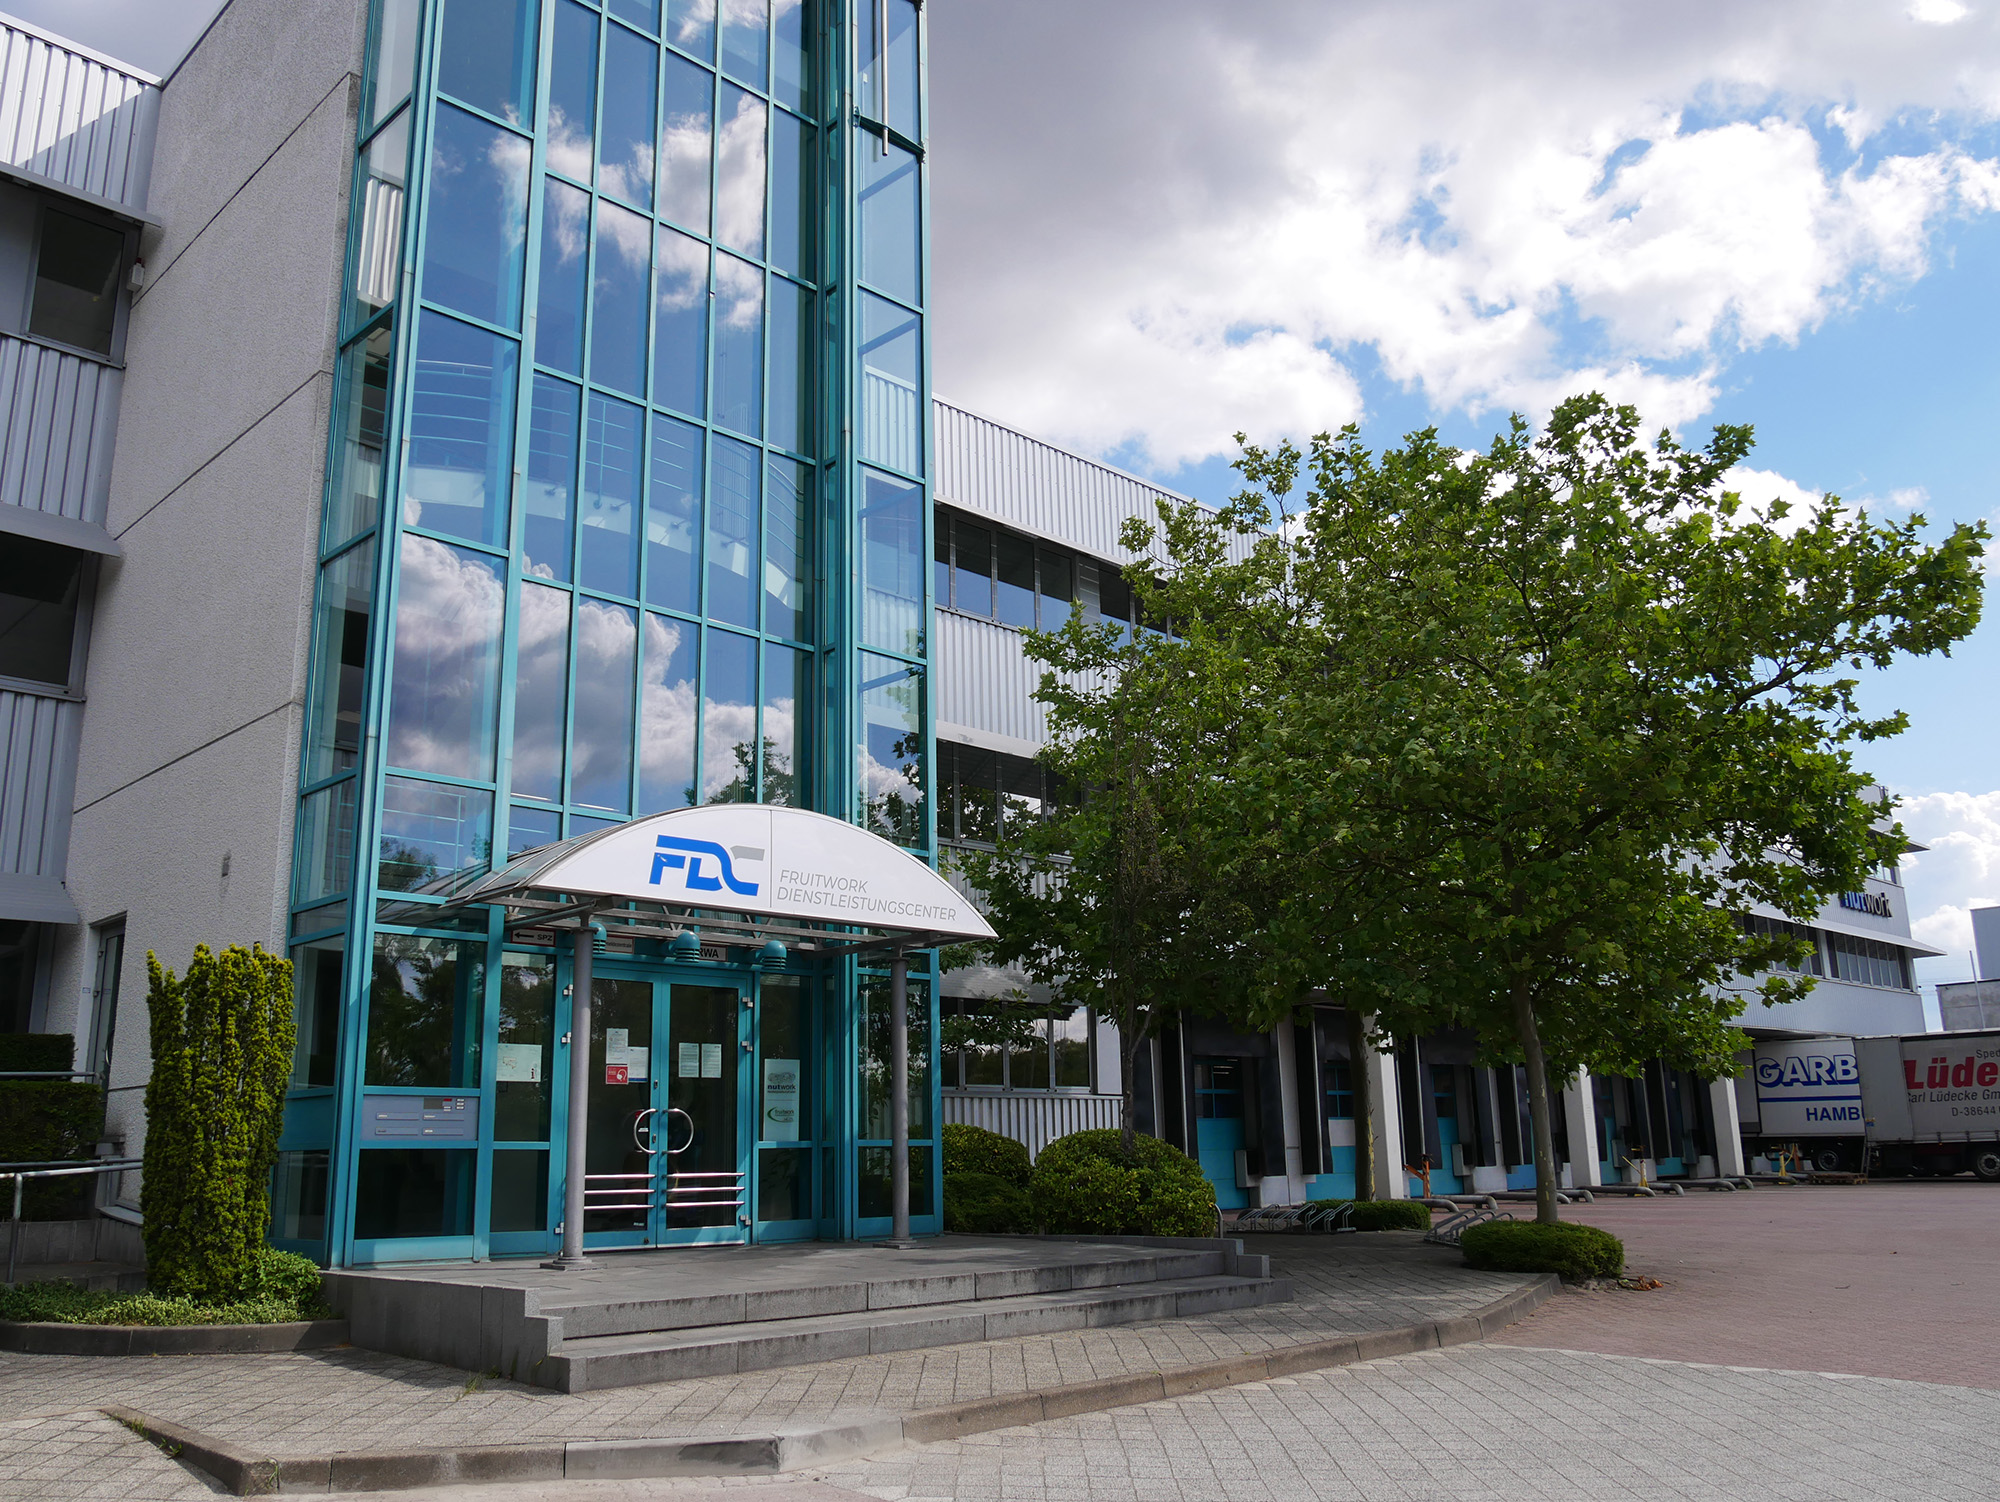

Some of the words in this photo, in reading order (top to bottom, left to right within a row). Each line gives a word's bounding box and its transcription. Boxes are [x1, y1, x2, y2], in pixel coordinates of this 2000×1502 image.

[649, 834, 765, 897] FDC
[780, 869, 868, 894] FRUITWORK
[777, 886, 957, 921] DIENSTLEISTUNGSCENTER
[700, 948, 719, 958] RWA
[1755, 1054, 1859, 1088] GARB
[1903, 1056, 1998, 1090] Lüde
[1930, 1090, 1978, 1103] Lüdecke
[1952, 1106, 1996, 1117] D-38644
